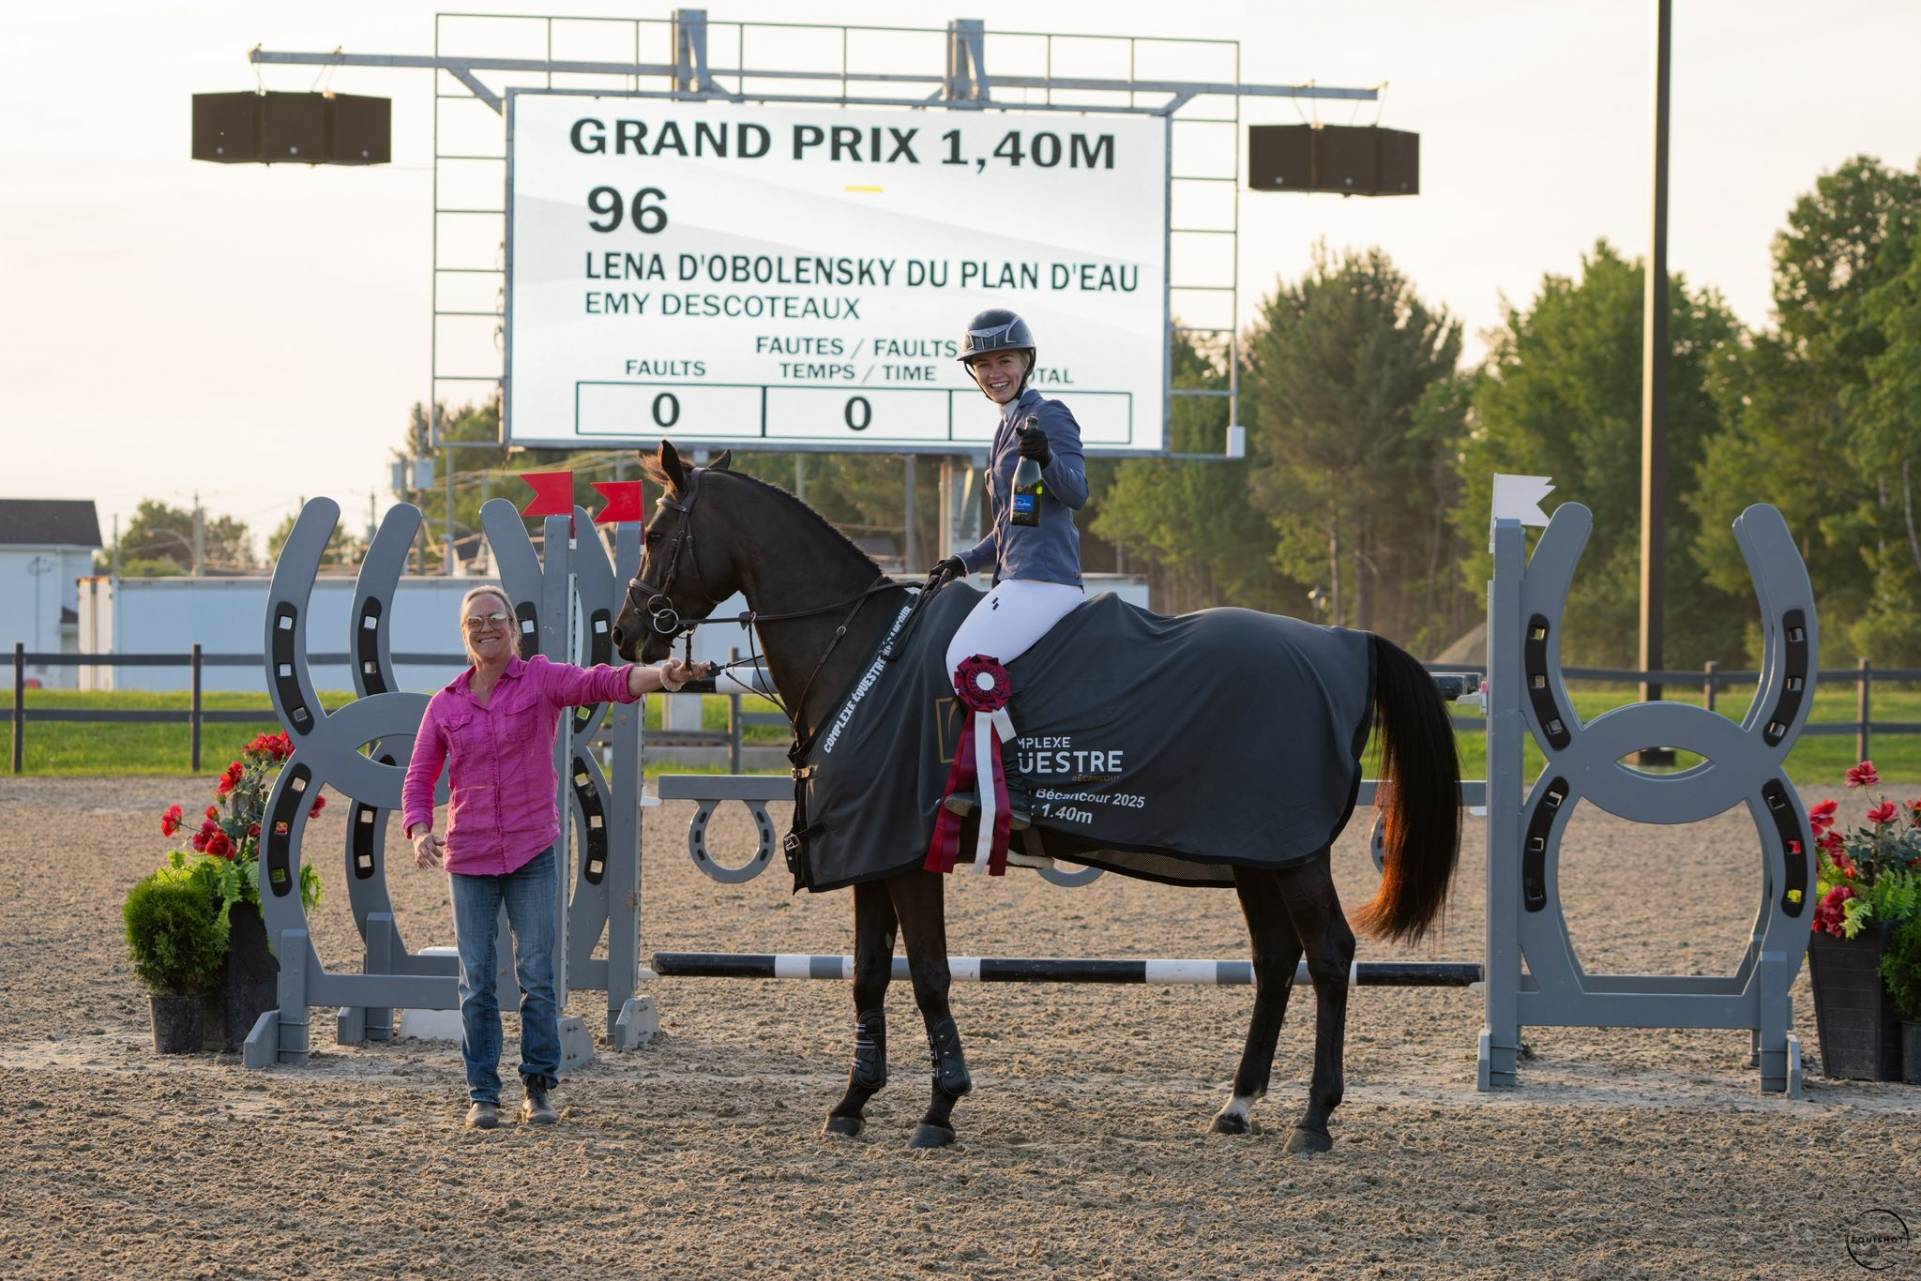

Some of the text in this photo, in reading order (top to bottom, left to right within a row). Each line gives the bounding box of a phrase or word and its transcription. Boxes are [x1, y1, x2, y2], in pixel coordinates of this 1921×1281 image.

[569, 117, 1116, 174] GRAND PRIX 1,40M
[587, 185, 668, 235] 96
[586, 251, 1138, 293] LENA D'OBOLENSKY DU PLAN D'EAU
[586, 292, 860, 321] EMY DESCOTEAUX
[756, 336, 844, 356] FAUTES
[874, 339, 958, 358] FAULTS
[626, 360, 706, 376] FAULTS
[780, 363, 856, 380] TEMPS
[884, 365, 937, 381] TIME
[651, 392, 681, 428] 0
[844, 395, 873, 432] 0
[824, 700, 856, 754] COMPLEXE
[1016, 736, 1072, 750] MPLEXE
[1040, 803, 1094, 825] 1.40m
[1112, 793, 1147, 809] 2025
